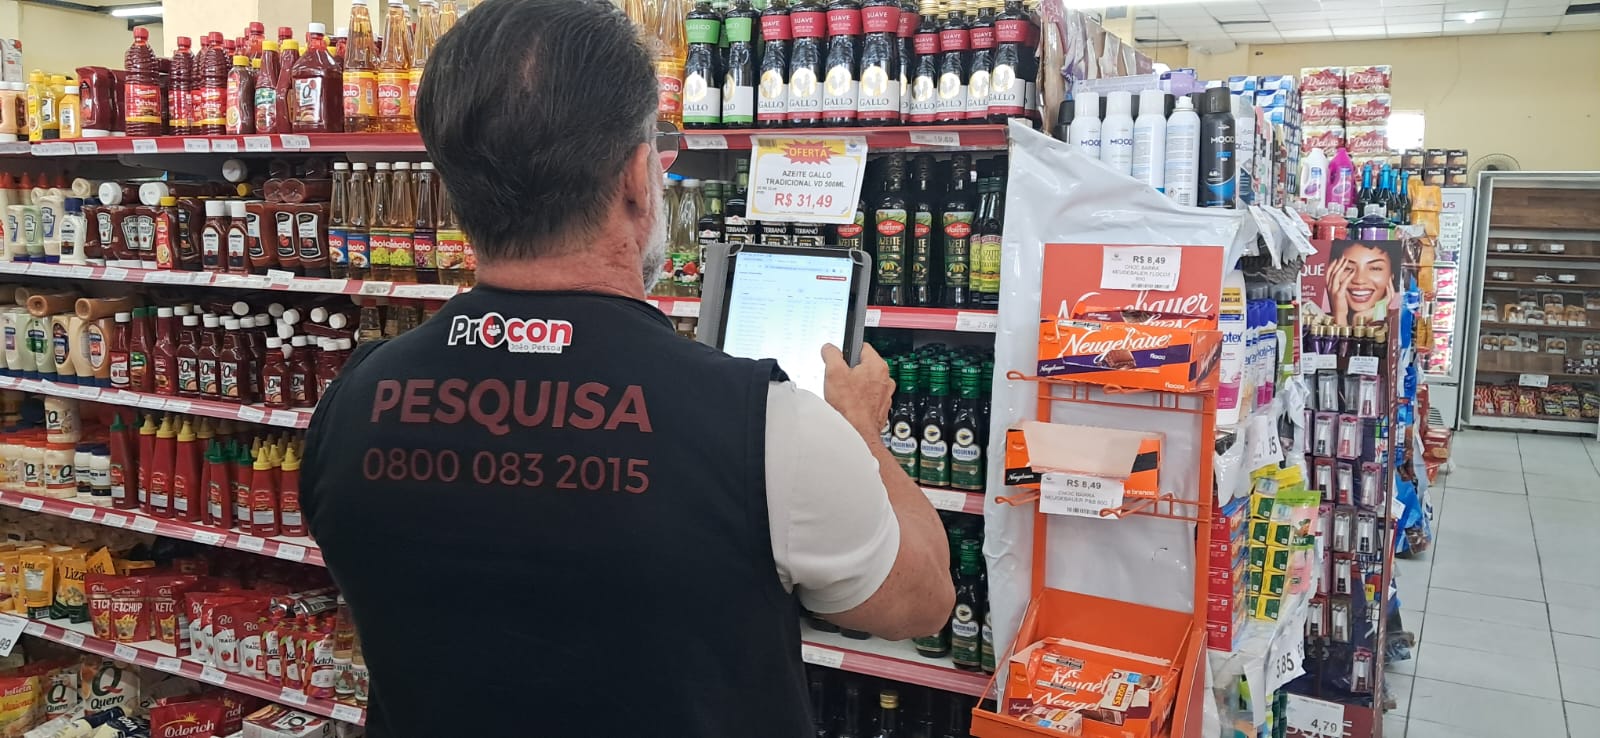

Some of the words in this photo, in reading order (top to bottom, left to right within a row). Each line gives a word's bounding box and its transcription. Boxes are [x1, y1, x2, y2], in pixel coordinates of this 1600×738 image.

[789, 99, 818, 107] GALLO
[824, 97, 853, 106] GALLO
[859, 97, 889, 106] GALLO
[789, 148, 828, 158] OFERTA
[766, 178, 812, 187] TRADICIONAL
[774, 192, 793, 207] R$
[796, 193, 833, 208] 31,49
[1133, 256, 1145, 264] R$
[1147, 257, 1166, 265] 8,49
[449, 313, 572, 347] Procon
[370, 378, 653, 436] PESQUISA
[363, 448, 461, 483] 0800
[472, 451, 545, 487] 083
[556, 454, 649, 494] 2015
[1066, 478, 1079, 487] R$
[64, 566, 85, 581] Liza
[91, 694, 124, 710] Quero
